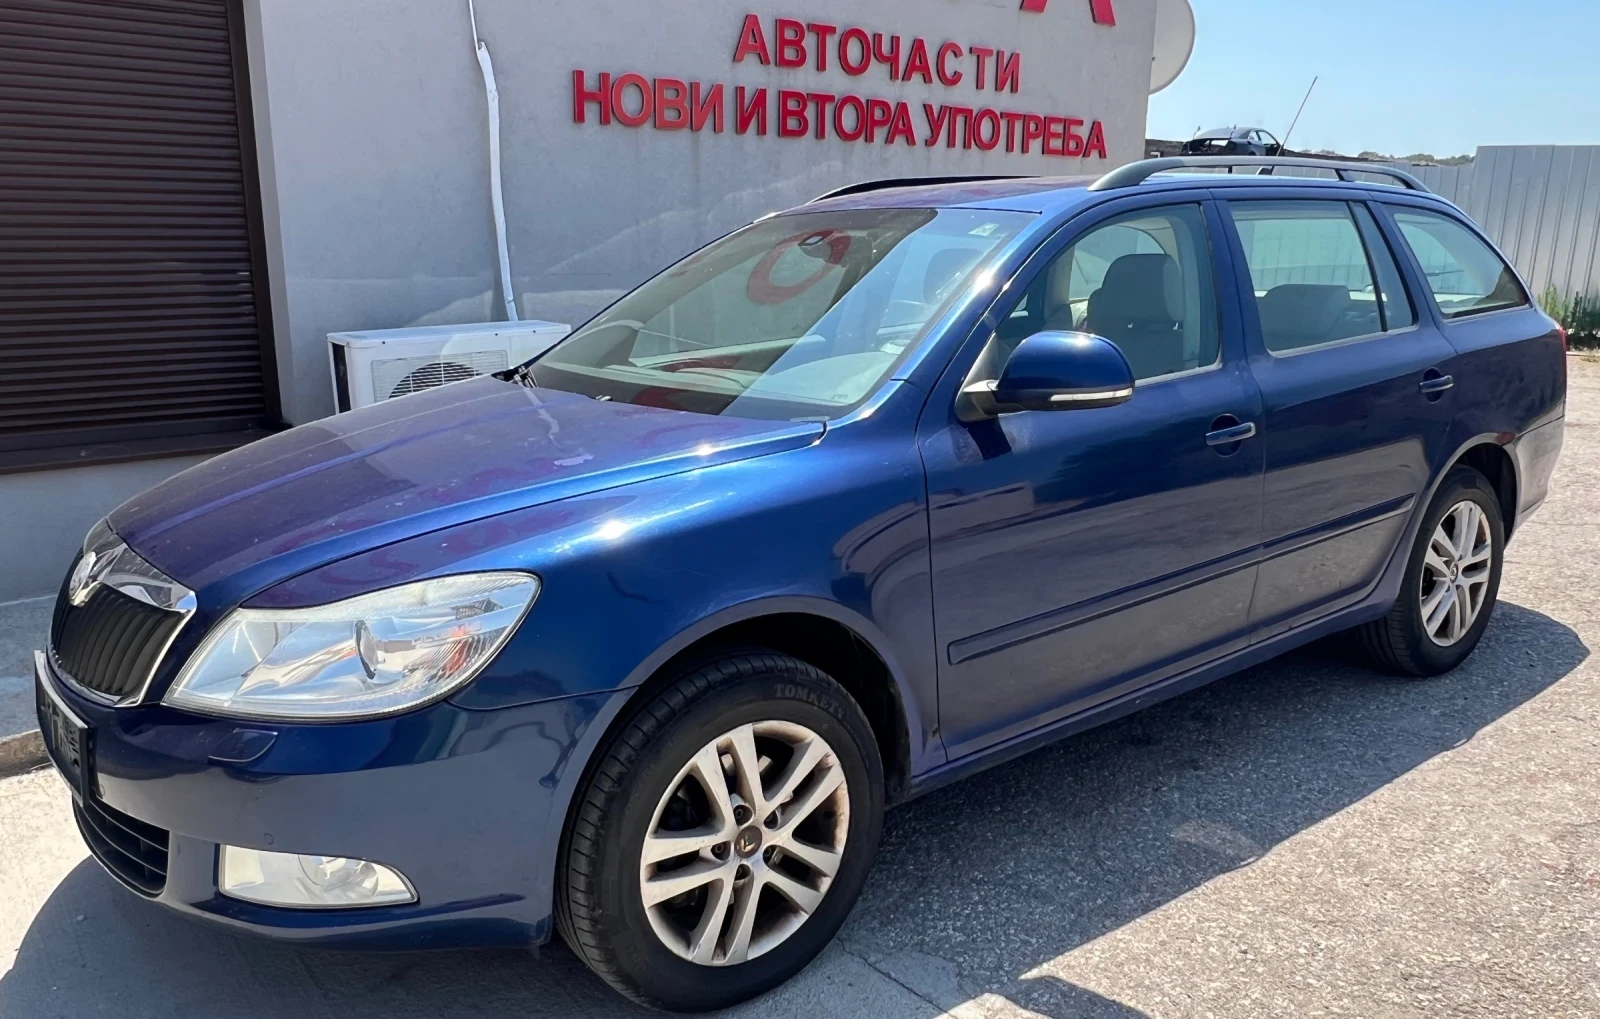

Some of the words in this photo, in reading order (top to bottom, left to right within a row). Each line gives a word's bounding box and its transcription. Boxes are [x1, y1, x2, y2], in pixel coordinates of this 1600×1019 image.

[732, 13, 1021, 94] АВТОЧАСТИ
[572, 69, 724, 134] НОВИ
[734, 85, 768, 136] И
[778, 90, 917, 147] ВТОРА
[924, 103, 1107, 159] УПОТРЕБА
